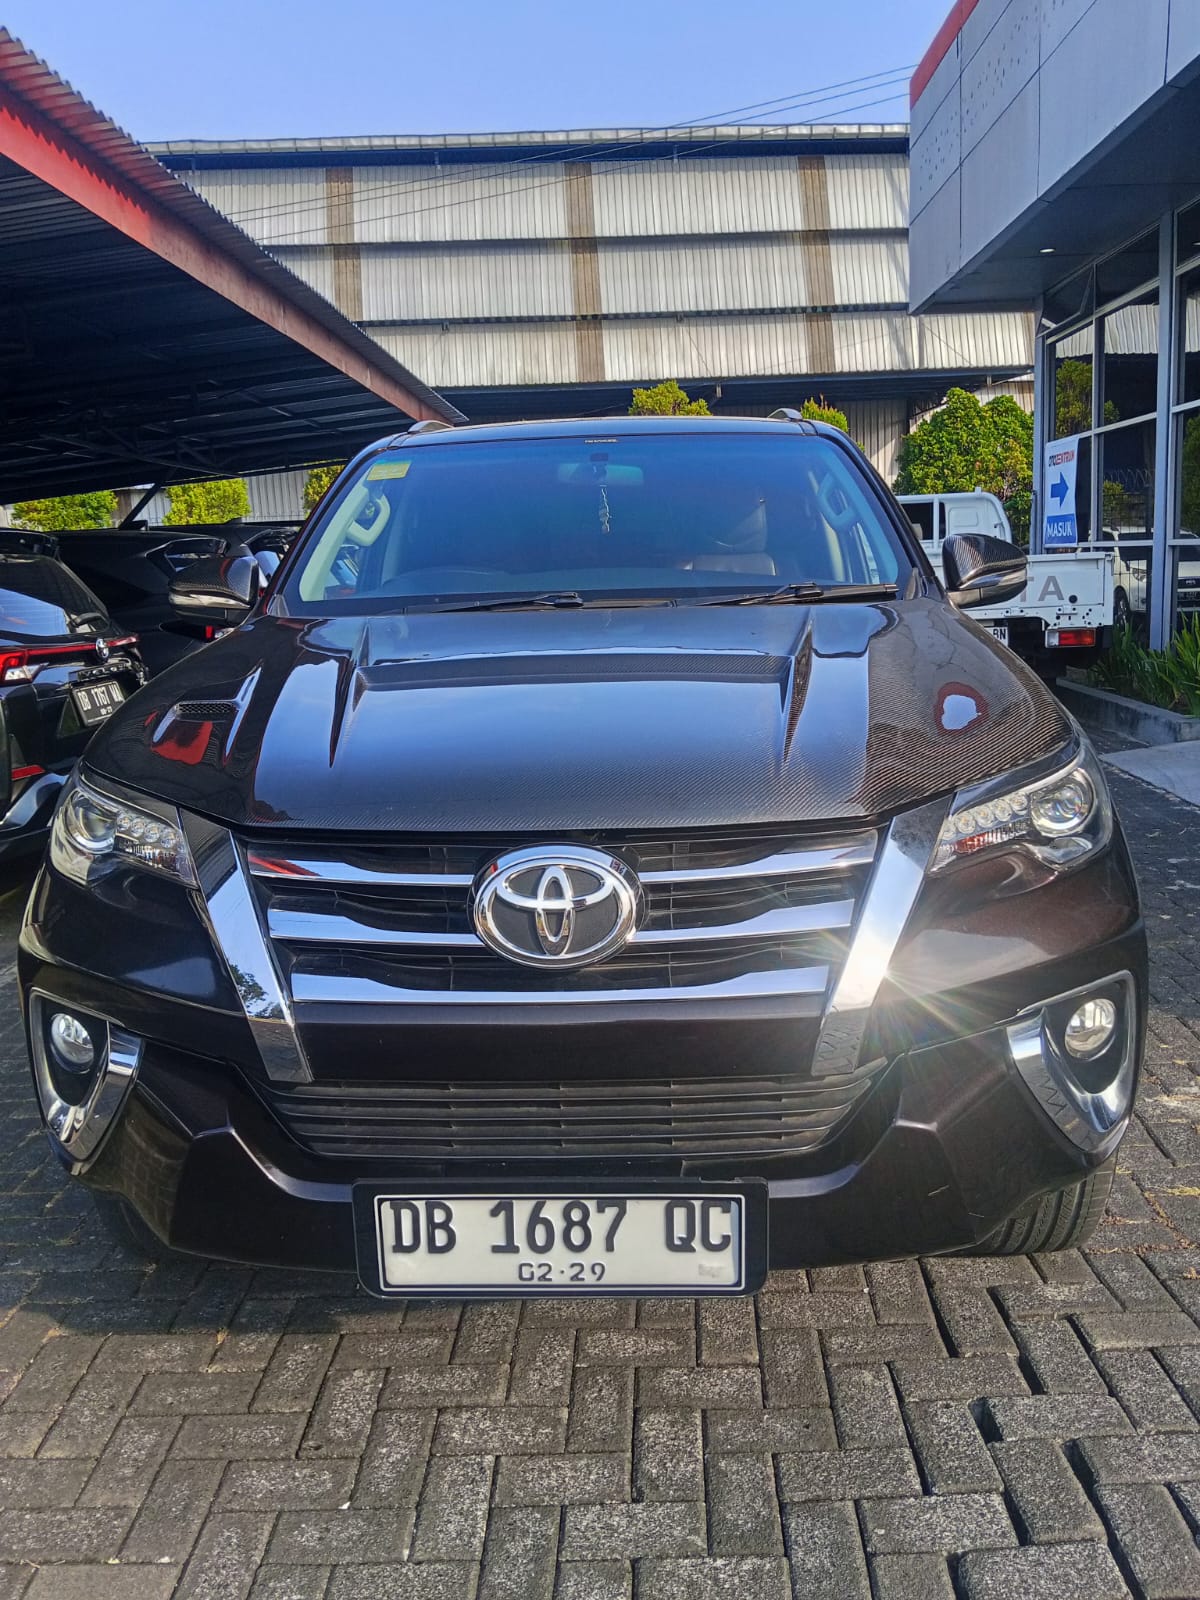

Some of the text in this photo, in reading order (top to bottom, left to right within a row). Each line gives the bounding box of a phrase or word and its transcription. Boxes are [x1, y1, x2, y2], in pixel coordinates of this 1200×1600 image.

[1047, 521, 1073, 537] MASUK
[389, 1200, 732, 1255] DB 1687 QC
